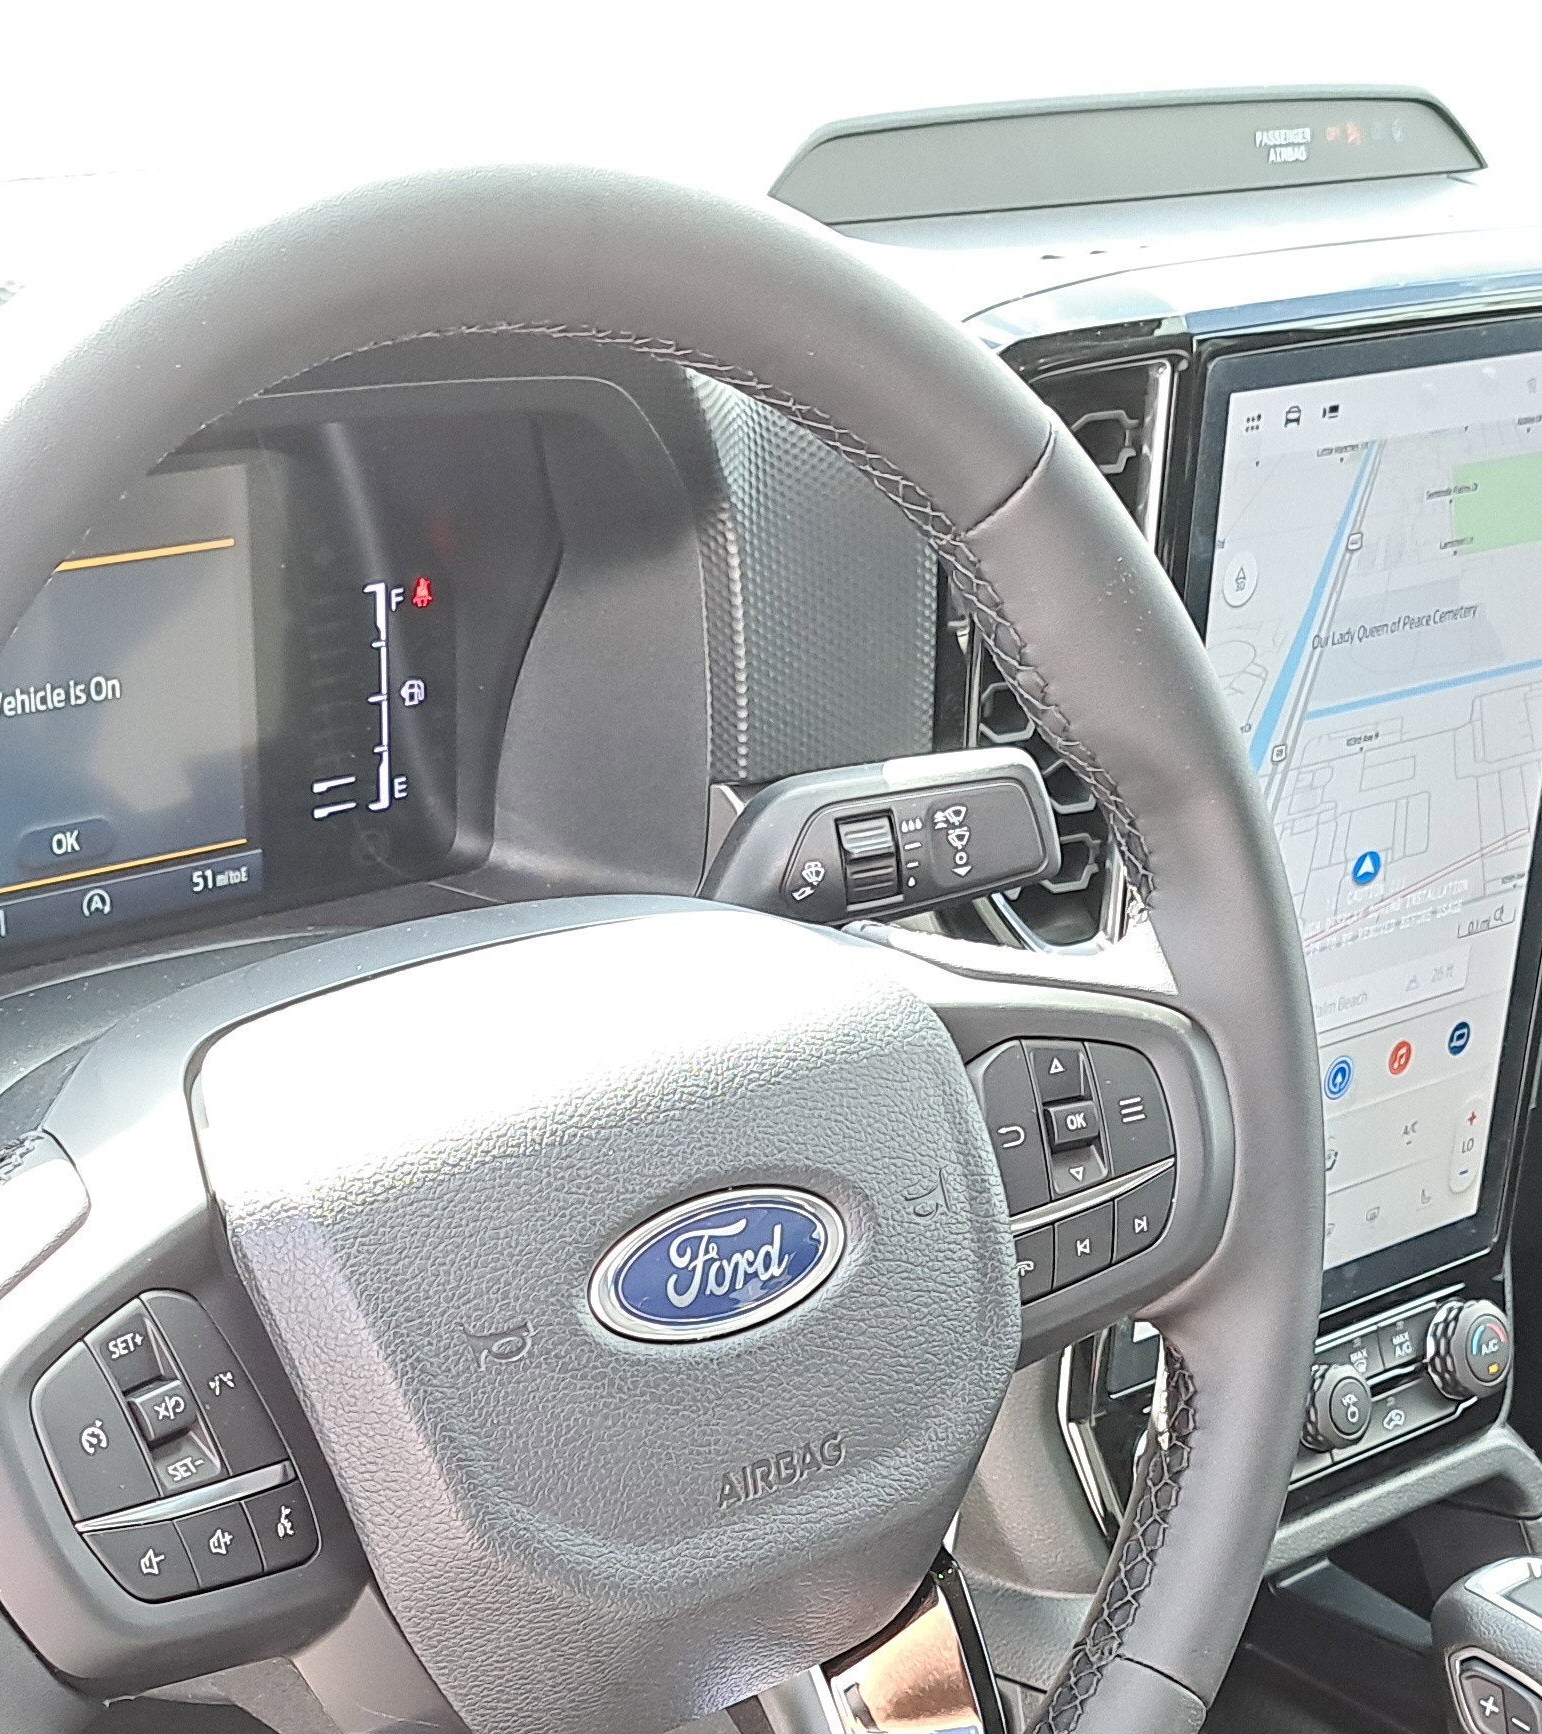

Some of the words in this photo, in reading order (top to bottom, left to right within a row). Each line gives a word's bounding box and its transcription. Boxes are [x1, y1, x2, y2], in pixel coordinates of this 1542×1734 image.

[390, 588, 404, 612] F
[1312, 632, 1329, 650] Our
[1332, 626, 1355, 648] Lady
[1359, 621, 1390, 643] Queen
[1390, 616, 1401, 634] of
[1403, 613, 1431, 632] Peace
[1433, 604, 1478, 627] Cemetery
[69, 680, 86, 706] is
[90, 675, 122, 702] On
[393, 776, 408, 799] E
[52, 829, 81, 856] OK
[192, 869, 213, 892] 51
[1066, 1112, 1087, 1131] OK
[666, 1218, 795, 1308] Ford
[715, 1431, 846, 1509] AIRBAG
